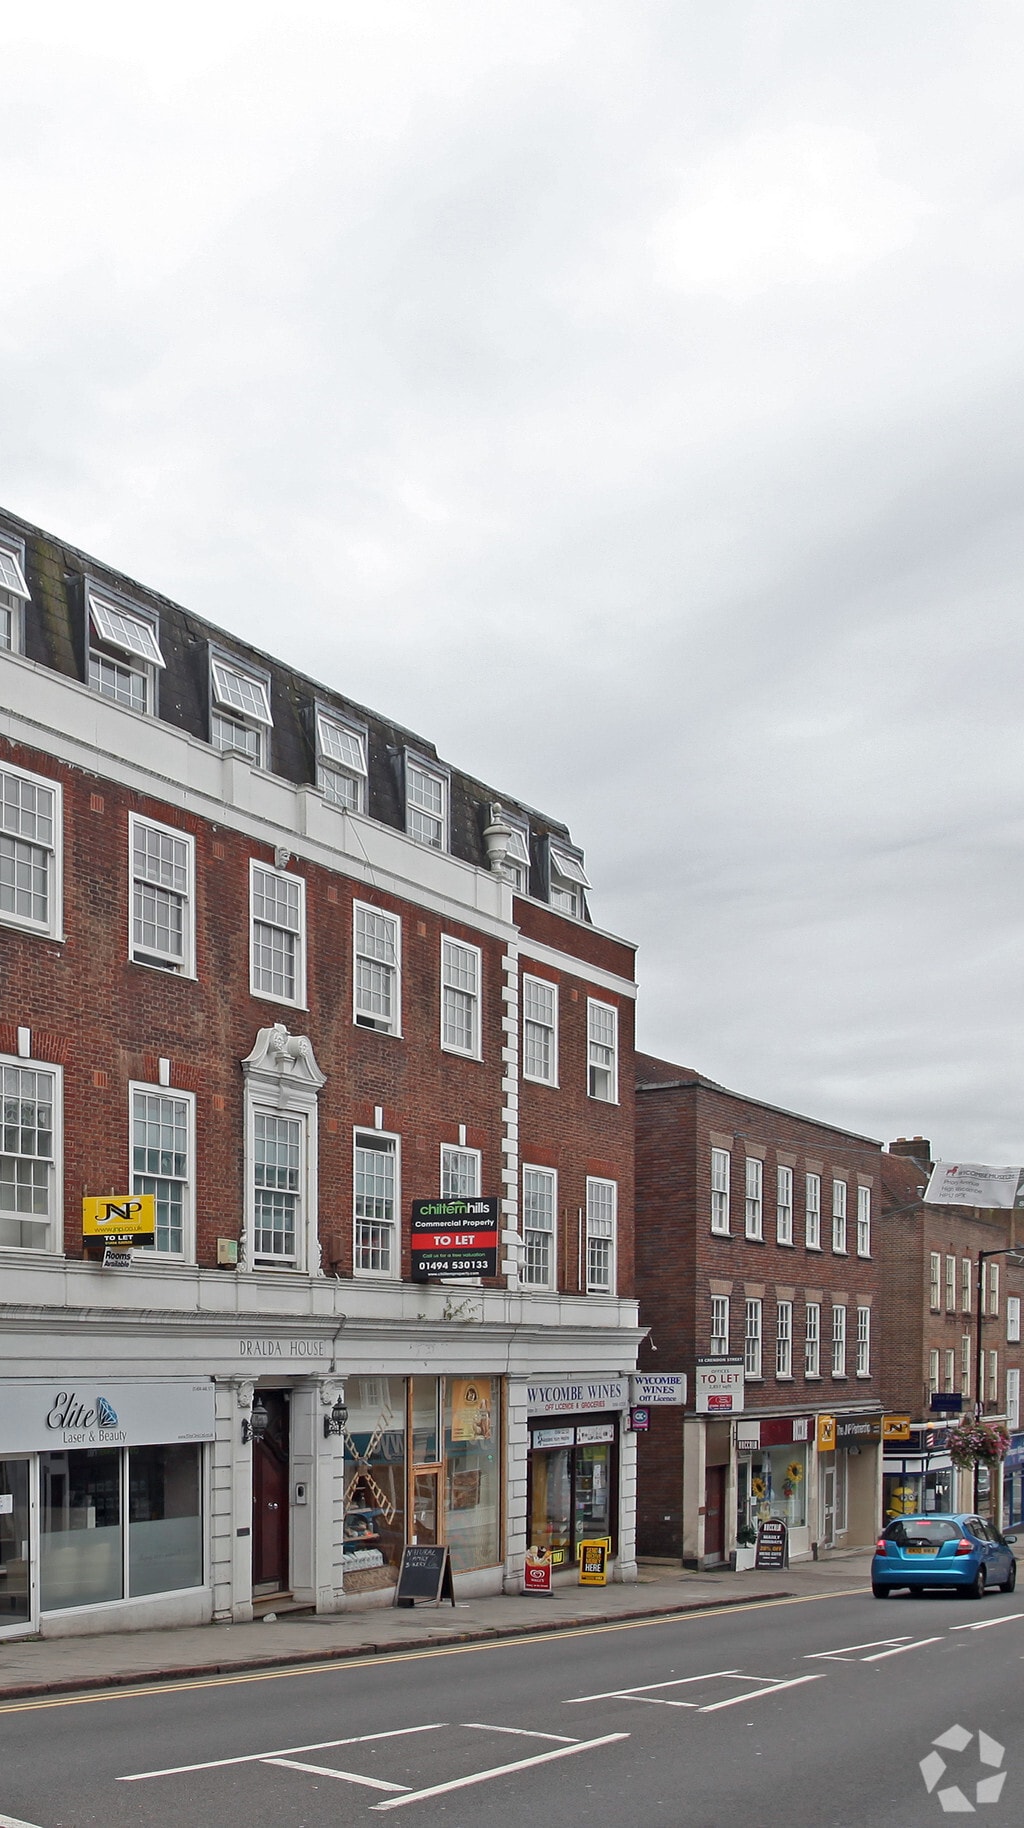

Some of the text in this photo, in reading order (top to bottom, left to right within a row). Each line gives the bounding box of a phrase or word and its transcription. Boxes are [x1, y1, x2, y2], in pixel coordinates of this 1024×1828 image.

[95, 1202, 143, 1222] JNP
[420, 1201, 490, 1215] chilternhills
[94, 1225, 143, 1233] www.jnp.co.uk
[415, 1219, 495, 1228] Commercial Property
[433, 1235, 475, 1246] TO LET
[105, 1250, 131, 1260] Rooms
[103, 1260, 130, 1268] Available
[418, 1260, 489, 1270] 01494 530133
[239, 1340, 324, 1356] DRALDA HOUSE
[635, 1377, 682, 1385] WYCOMBE
[701, 1373, 740, 1384] TO LET
[527, 1384, 622, 1403] WYCOMBE WINES
[642, 1386, 675, 1394] WINES
[47, 1392, 97, 1429] Elite
[545, 1403, 554, 1411] OFF
[554, 1402, 574, 1410] LICENCE
[581, 1400, 606, 1409] GROCERIES
[836, 1424, 844, 1436] The
[63, 1429, 127, 1443] Laser & Beauty
[585, 1563, 601, 1572] HERE
